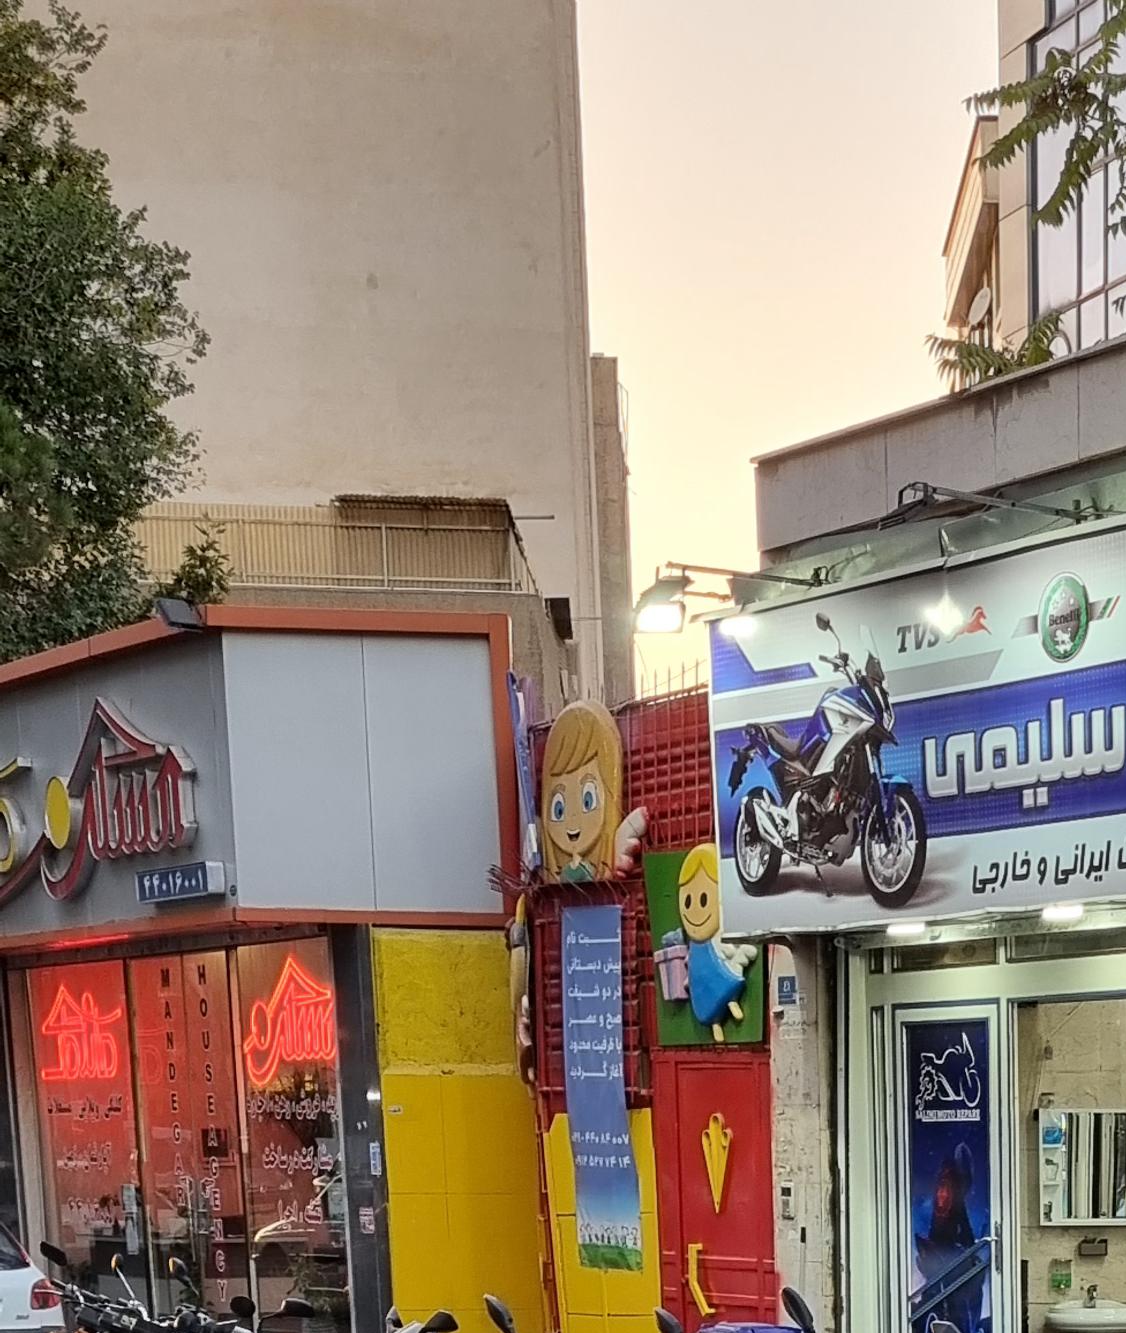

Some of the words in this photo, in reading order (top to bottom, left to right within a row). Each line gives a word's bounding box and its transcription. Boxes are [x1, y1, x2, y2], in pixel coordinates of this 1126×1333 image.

[896, 623, 940, 654] TVS
[922, 697, 1126, 809] سلیمی
[971, 850, 1032, 894] خارجی
[1037, 855, 1048, 886] و
[1053, 840, 1112, 886] ایرانی
[197, 964, 216, 1115] HOUSE
[159, 967, 187, 1207] MANDEGAR
[207, 1124, 229, 1302] AGENCY
